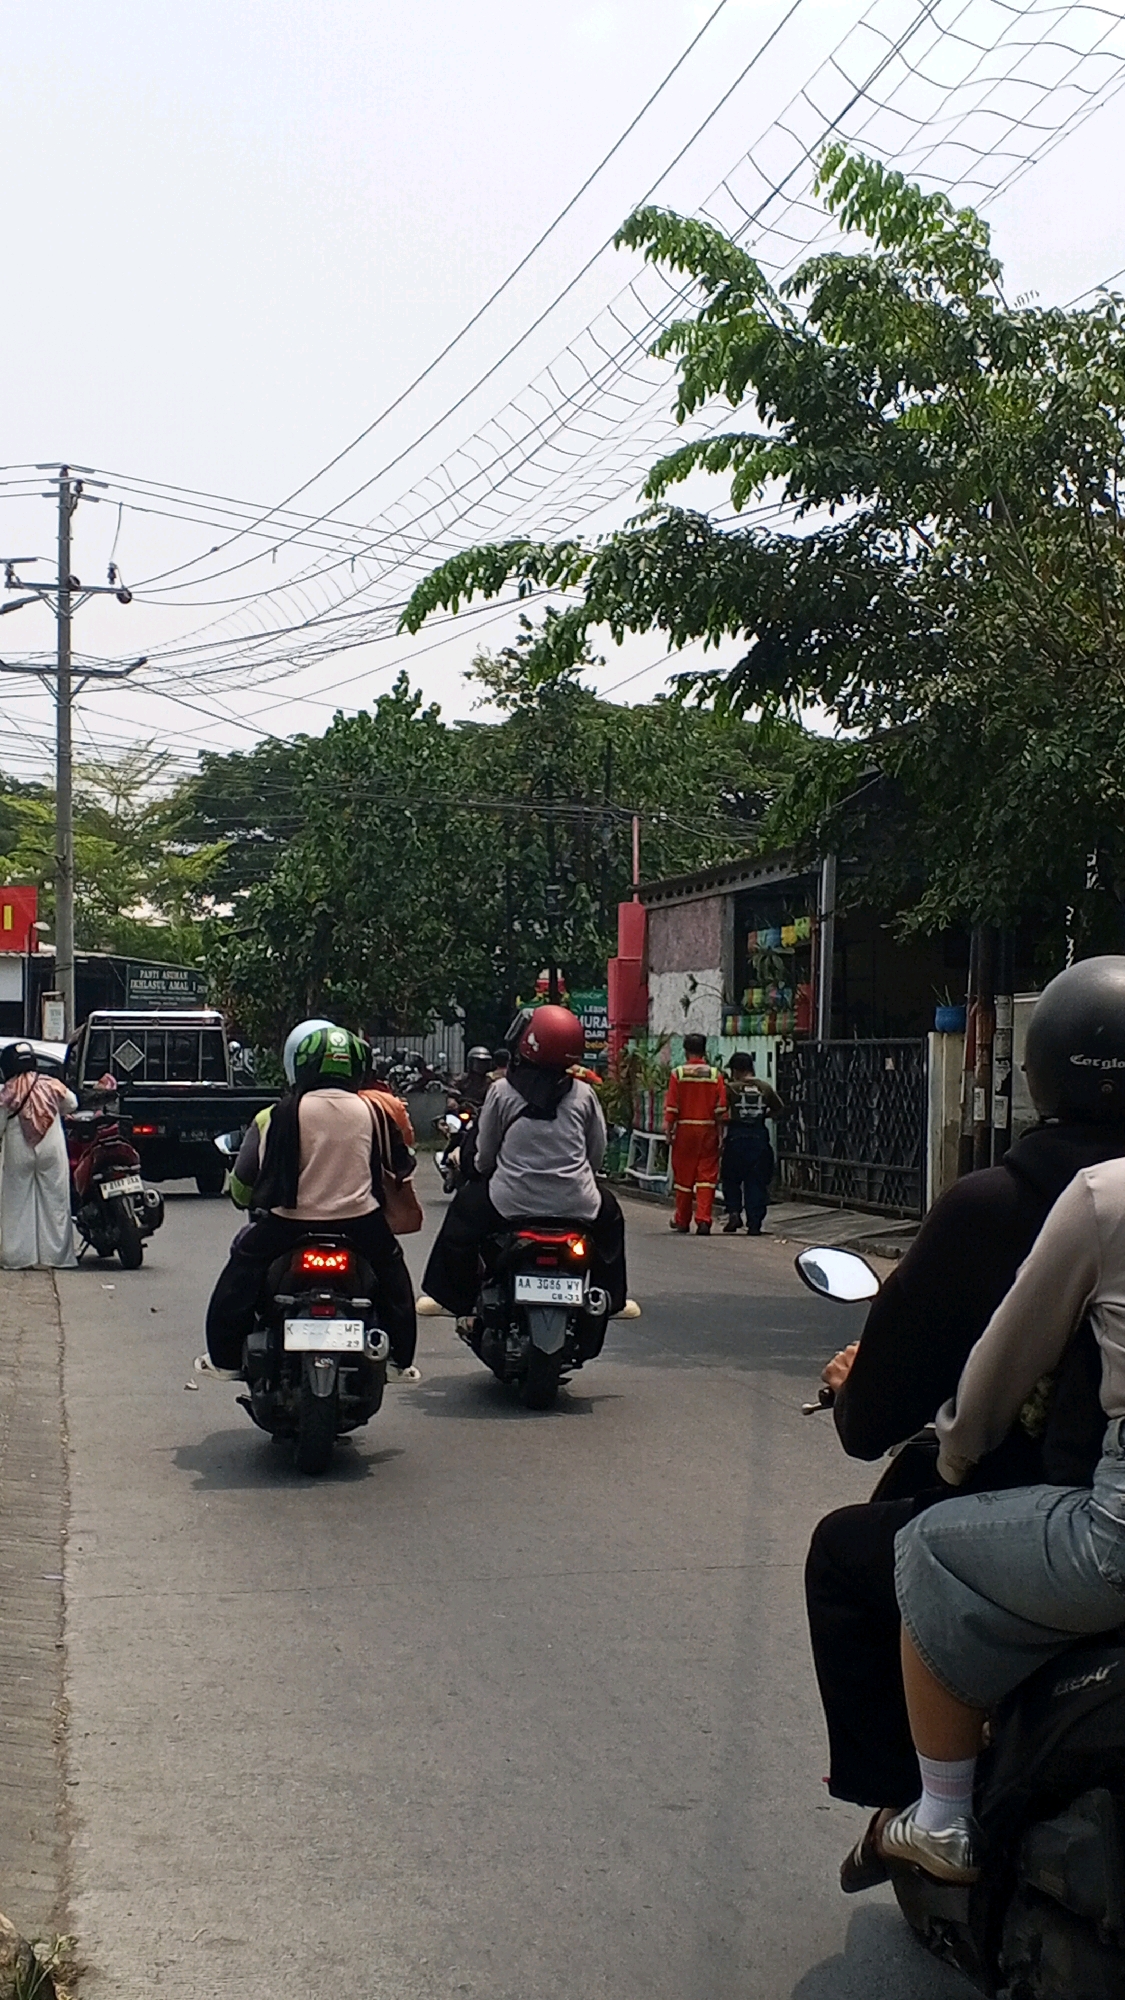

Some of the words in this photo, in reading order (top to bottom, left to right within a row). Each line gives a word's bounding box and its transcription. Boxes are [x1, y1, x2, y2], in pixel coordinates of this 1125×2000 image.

[140, 970, 160, 979] PANTI
[130, 979, 166, 990] IKHLASUL
[168, 981, 189, 991] AMAL
[584, 1005, 607, 1014] LEBIH
[585, 1030, 606, 1039] DARI
[518, 1278, 531, 1289] AA
[566, 1280, 580, 1291] WY
